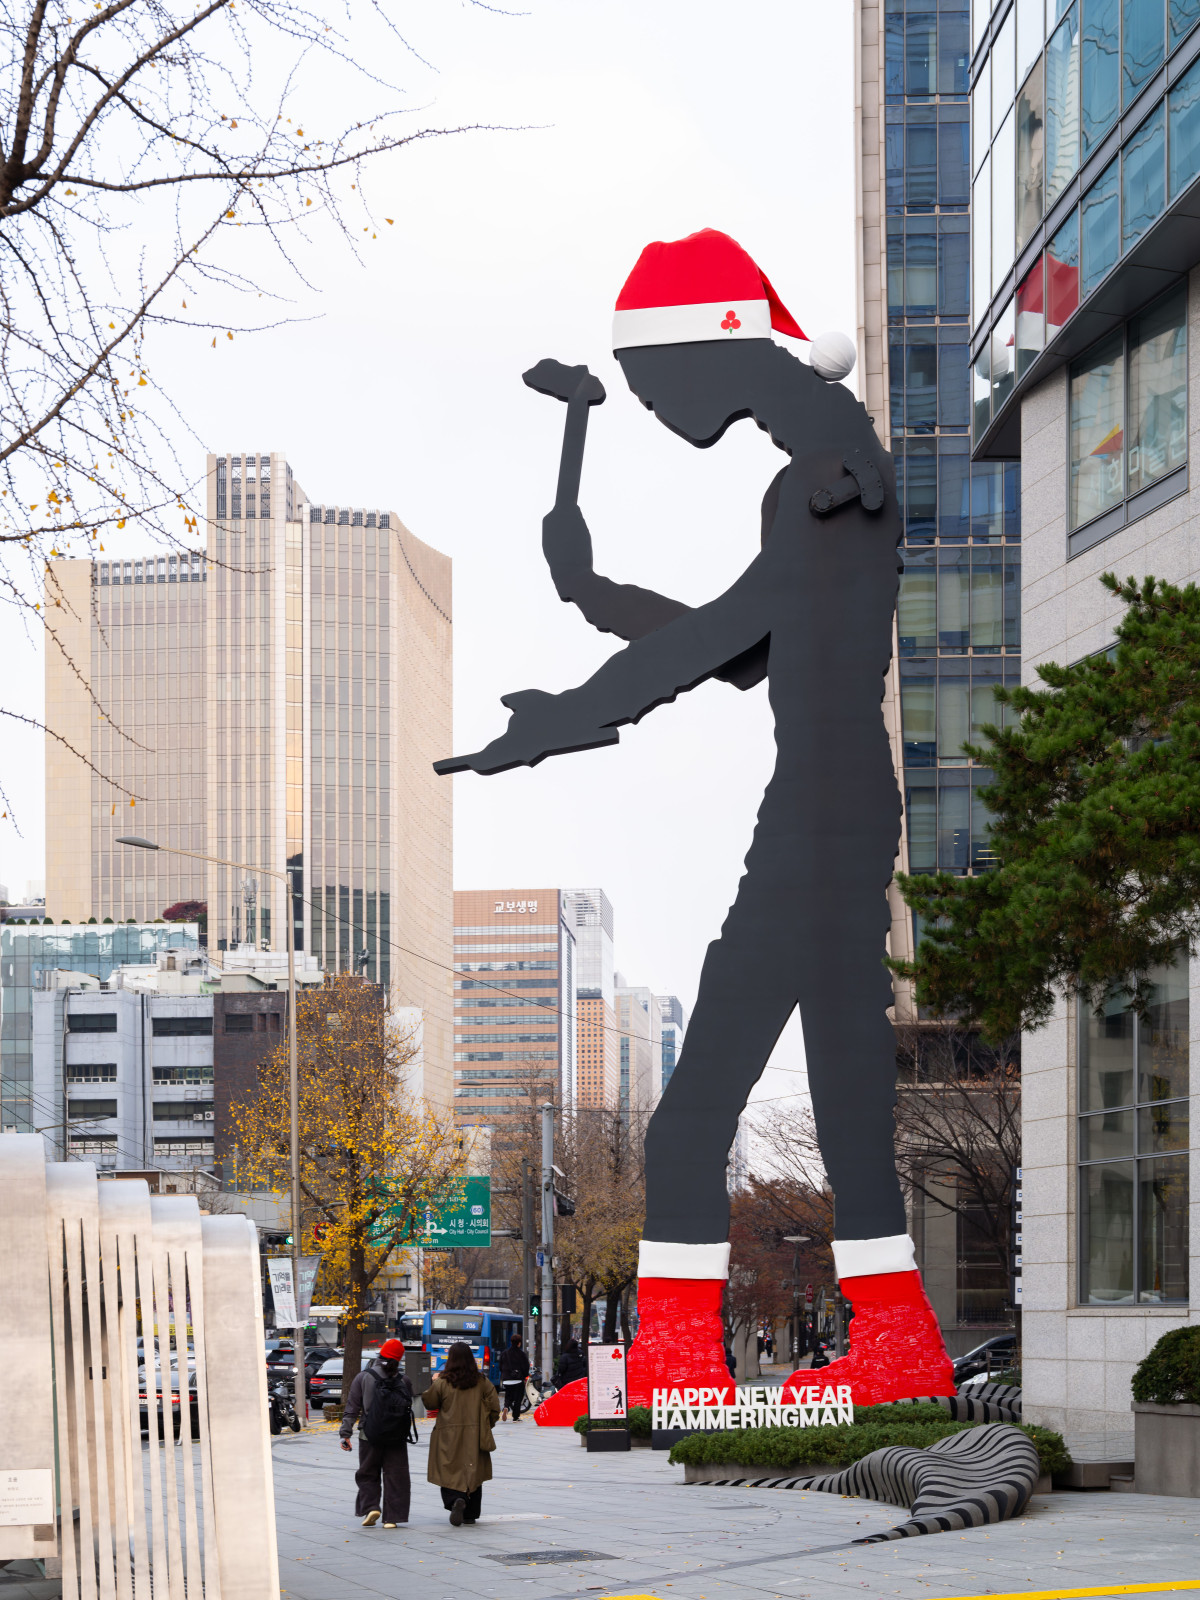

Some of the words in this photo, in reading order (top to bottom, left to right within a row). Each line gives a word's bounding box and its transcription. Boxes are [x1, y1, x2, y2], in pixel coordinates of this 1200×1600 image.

[493, 900, 538, 913] 교보생명
[469, 1218, 489, 1227] 시의회
[272, 1271, 290, 1282] 기억을
[273, 1282, 292, 1293] 미래로
[652, 1387, 729, 1407] HAPPY
[735, 1386, 784, 1406] NEW
[790, 1385, 852, 1405] YEAR
[652, 1406, 854, 1430] HAMMERINGMAN
